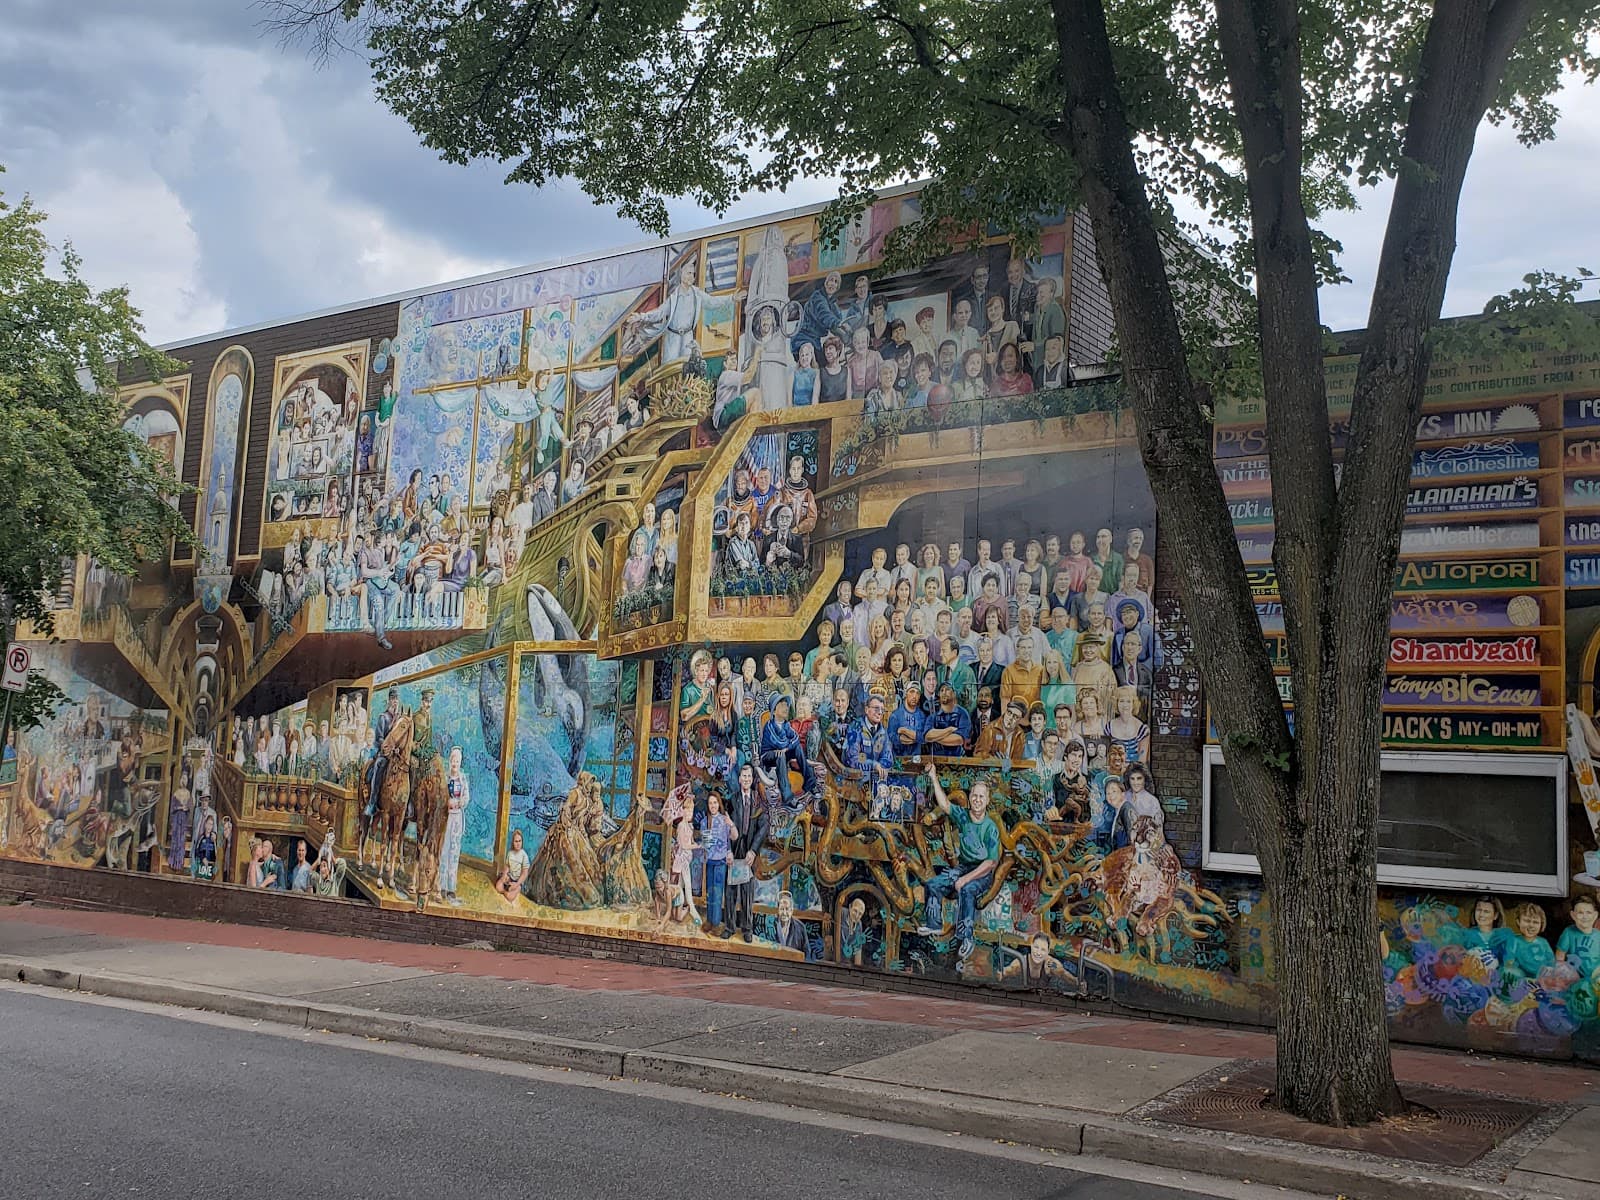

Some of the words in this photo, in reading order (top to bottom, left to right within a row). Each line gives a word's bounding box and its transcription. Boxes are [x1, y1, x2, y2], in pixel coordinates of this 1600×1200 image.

[451, 263, 622, 316] INSPIRATION
[1450, 376, 1537, 393] CONTRIBUTIONS
[1543, 370, 1574, 383] FROM
[1454, 411, 1491, 434] INN
[1237, 461, 1266, 469] THE
[1439, 455, 1539, 474] Clothesline
[1391, 637, 1536, 663] Shandygaff
[1382, 715, 1452, 740] JACK'S
